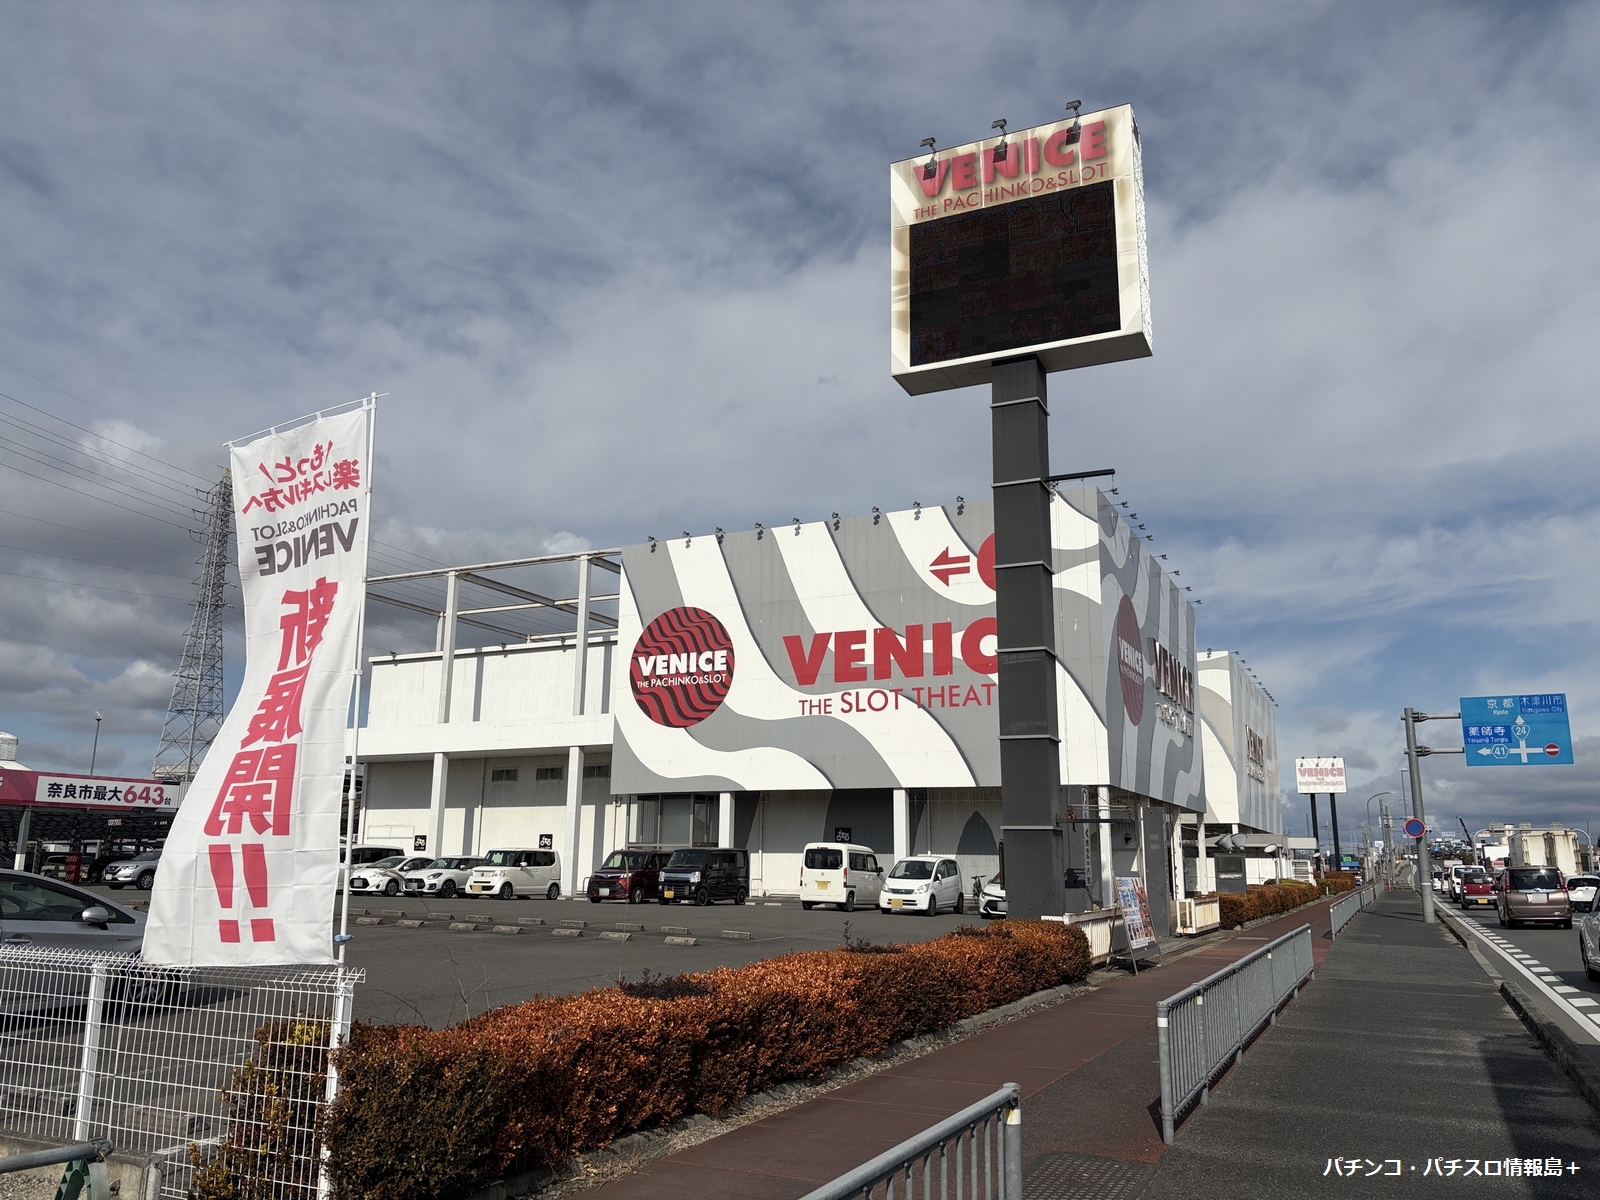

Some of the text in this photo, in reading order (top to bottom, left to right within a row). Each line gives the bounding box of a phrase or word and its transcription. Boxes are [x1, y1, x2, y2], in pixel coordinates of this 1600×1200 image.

[912, 120, 1107, 197] VENICE
[913, 162, 1108, 220] THE PACHINKO&SLOT
[636, 649, 728, 677] VENICE
[636, 673, 727, 689] THE PACHINKO&SLOT
[799, 699, 833, 716] THE
[840, 689, 904, 714] SLOT
[1486, 695, 1563, 709] 京都 木津川市
[1515, 726, 1526, 735] 24
[1494, 747, 1506, 756] 41
[1298, 768, 1344, 777] VENICE
[47, 782, 172, 805] 奈良市最大643台
